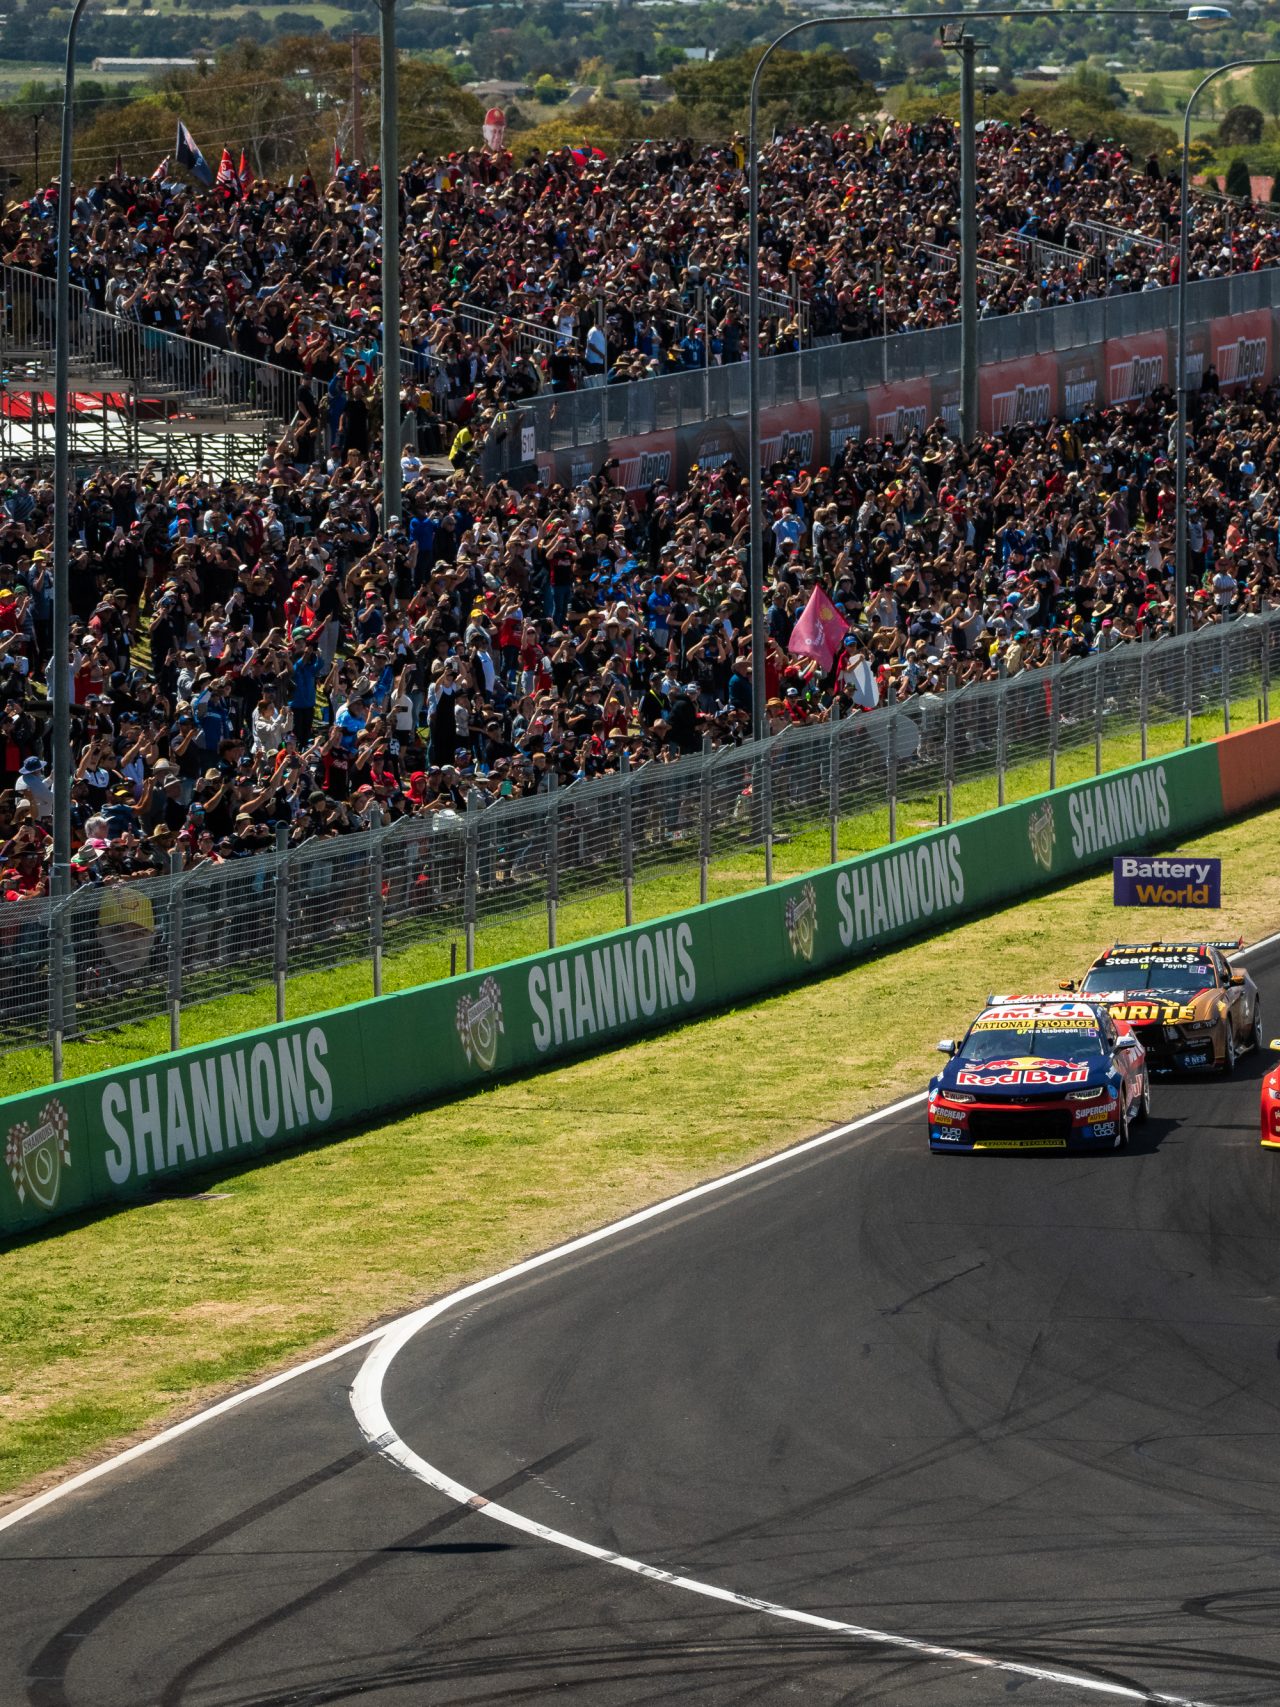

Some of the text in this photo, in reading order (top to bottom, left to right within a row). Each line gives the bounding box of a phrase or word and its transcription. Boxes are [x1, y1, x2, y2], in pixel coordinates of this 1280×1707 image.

[639, 451, 671, 486] Repco
[1069, 766, 1170, 859] SHANNONS
[1121, 858, 1211, 884] Battery
[836, 834, 964, 947] SHANNONS
[1135, 884, 1210, 905] World
[1105, 955, 1180, 966] Steadfast
[1111, 946, 1198, 956] PENRITE
[529, 922, 696, 1053] SHANNONS
[1109, 1004, 1196, 1021] NRITE
[975, 1020, 1094, 1029] NATIONAL STORAGE
[957, 1068, 1090, 1087] Red Bull
[102, 1026, 333, 1185] SHANNONS
[1075, 1102, 1118, 1119] SUPERCHEAP
